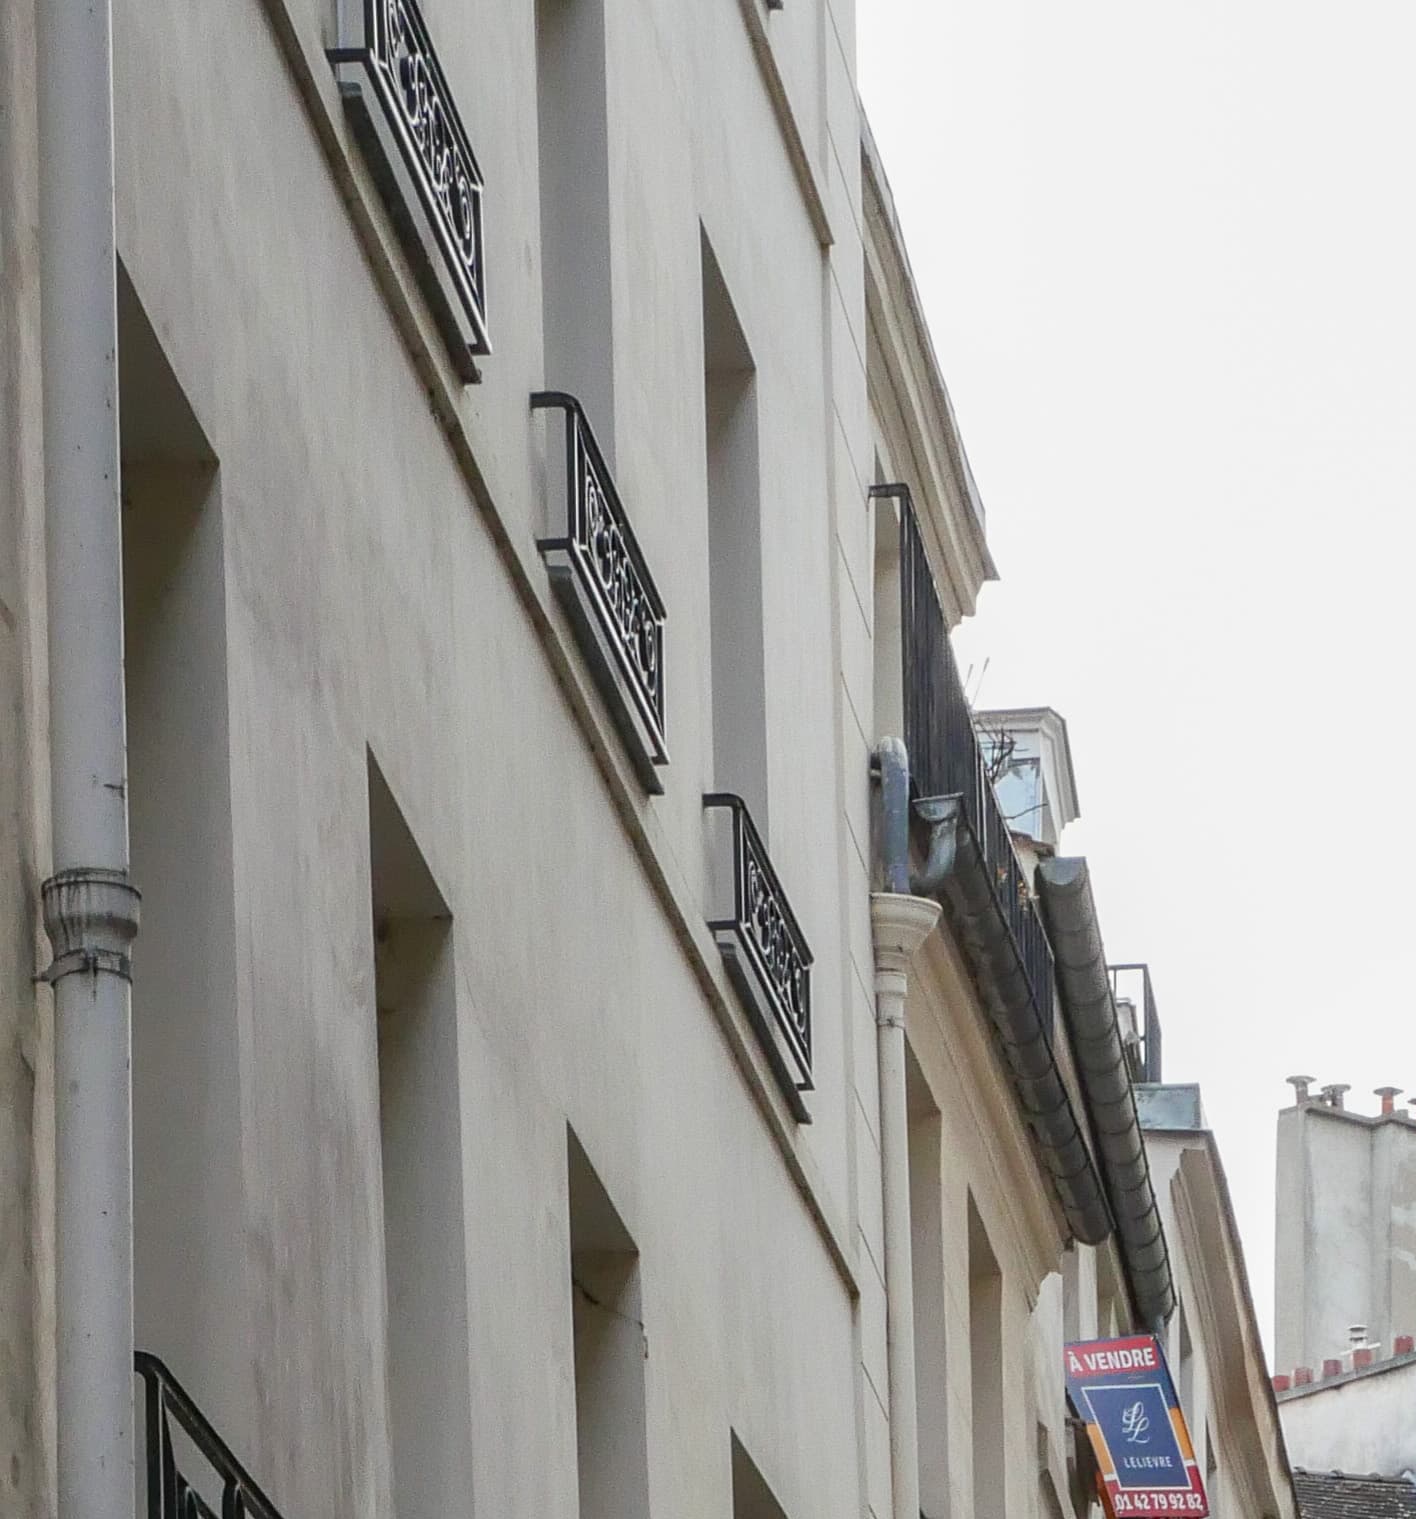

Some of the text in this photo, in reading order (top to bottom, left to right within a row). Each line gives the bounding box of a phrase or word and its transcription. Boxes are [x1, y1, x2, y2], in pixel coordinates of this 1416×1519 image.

[1067, 1347, 1156, 1372] À VENDRE
[1114, 1493, 1204, 1511] 01 42 79 92 82
